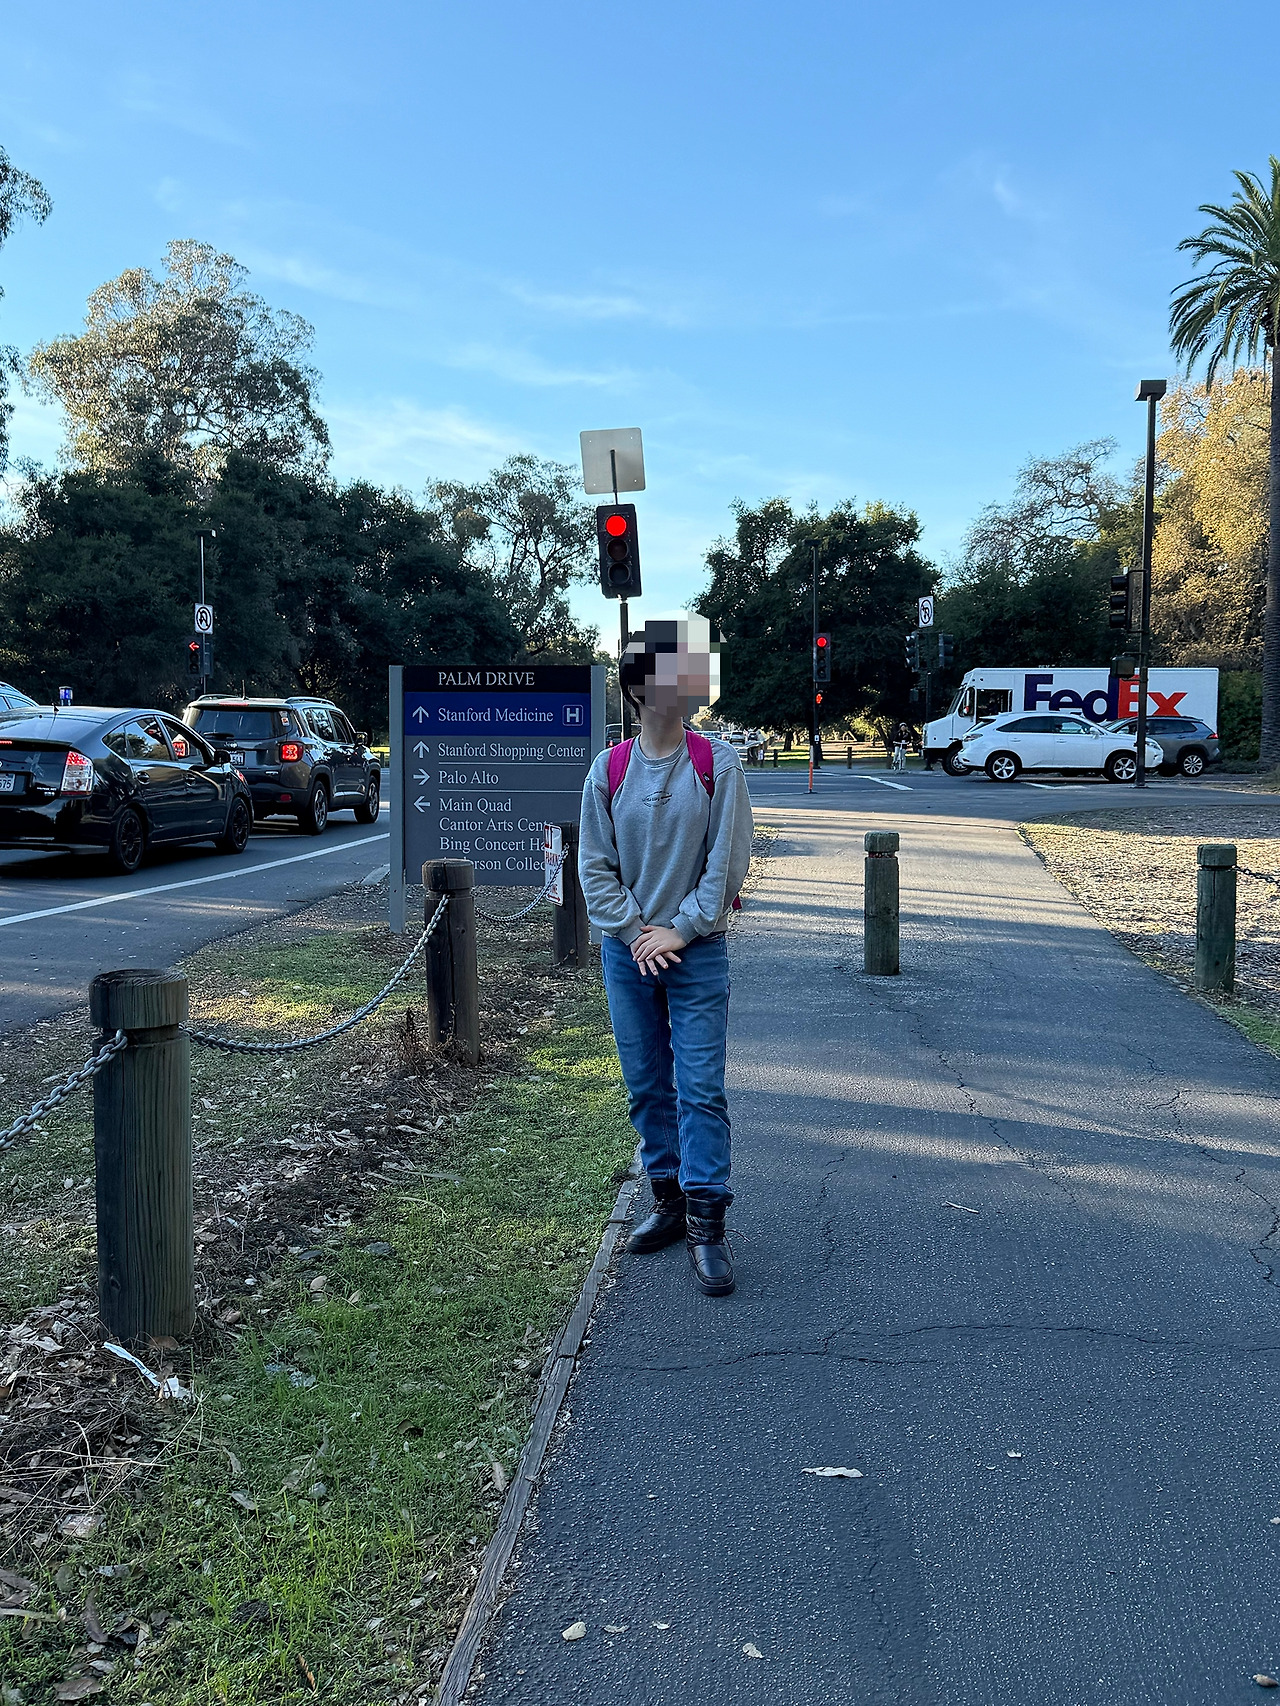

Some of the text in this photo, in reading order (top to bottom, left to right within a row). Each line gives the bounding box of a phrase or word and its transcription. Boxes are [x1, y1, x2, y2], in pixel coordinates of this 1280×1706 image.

[438, 672, 535, 686] PALM DRIVE
[1024, 674, 1188, 723] FedEx
[438, 707, 554, 722] Stanford Medicine
[566, 707, 580, 723] H
[438, 742, 585, 760] Stanford Shopping Center
[438, 770, 499, 784] Palo Alto
[438, 797, 512, 815] Main Quad
[439, 817, 553, 832] Cantor Arts Cen
[439, 837, 471, 854] Bing
[474, 837, 525, 851] Concert
[529, 837, 545, 851] Ha
[505, 856, 545, 870] Collec
